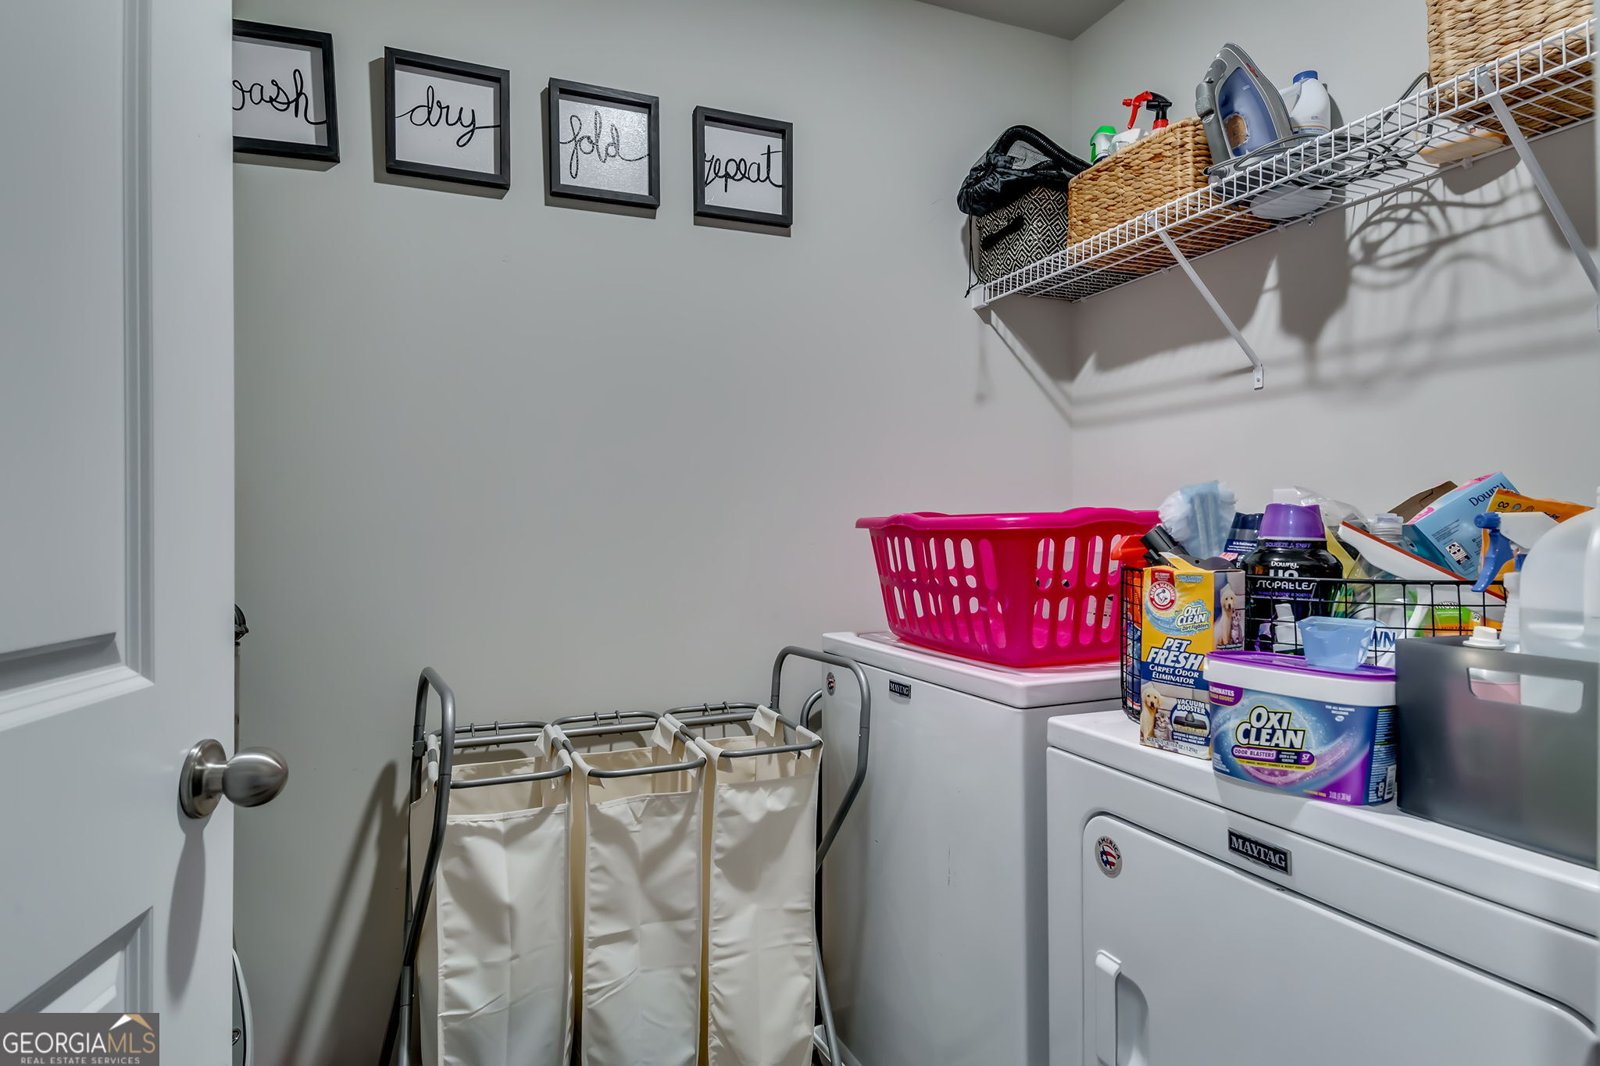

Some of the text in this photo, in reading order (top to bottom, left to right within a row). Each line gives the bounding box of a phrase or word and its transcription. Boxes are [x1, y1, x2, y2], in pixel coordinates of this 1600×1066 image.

[395, 85, 501, 148] dry
[560, 110, 650, 179] fold
[705, 144, 784, 193] repeat
[1270, 561, 1299, 569] Downy
[1177, 614, 1207, 626] CLEAN
[1184, 606, 1201, 617] OXI
[1163, 638, 1191, 652] PET
[1147, 648, 1204, 670] FRESH
[1177, 704, 1206, 715] BOOSTER
[1178, 699, 1205, 708] VACUUM
[1251, 707, 1290, 730] OXI
[1237, 722, 1304, 749] CLEAN
[1249, 750, 1275, 758] BLASTERS
[1231, 834, 1286, 867] MAYTAG
